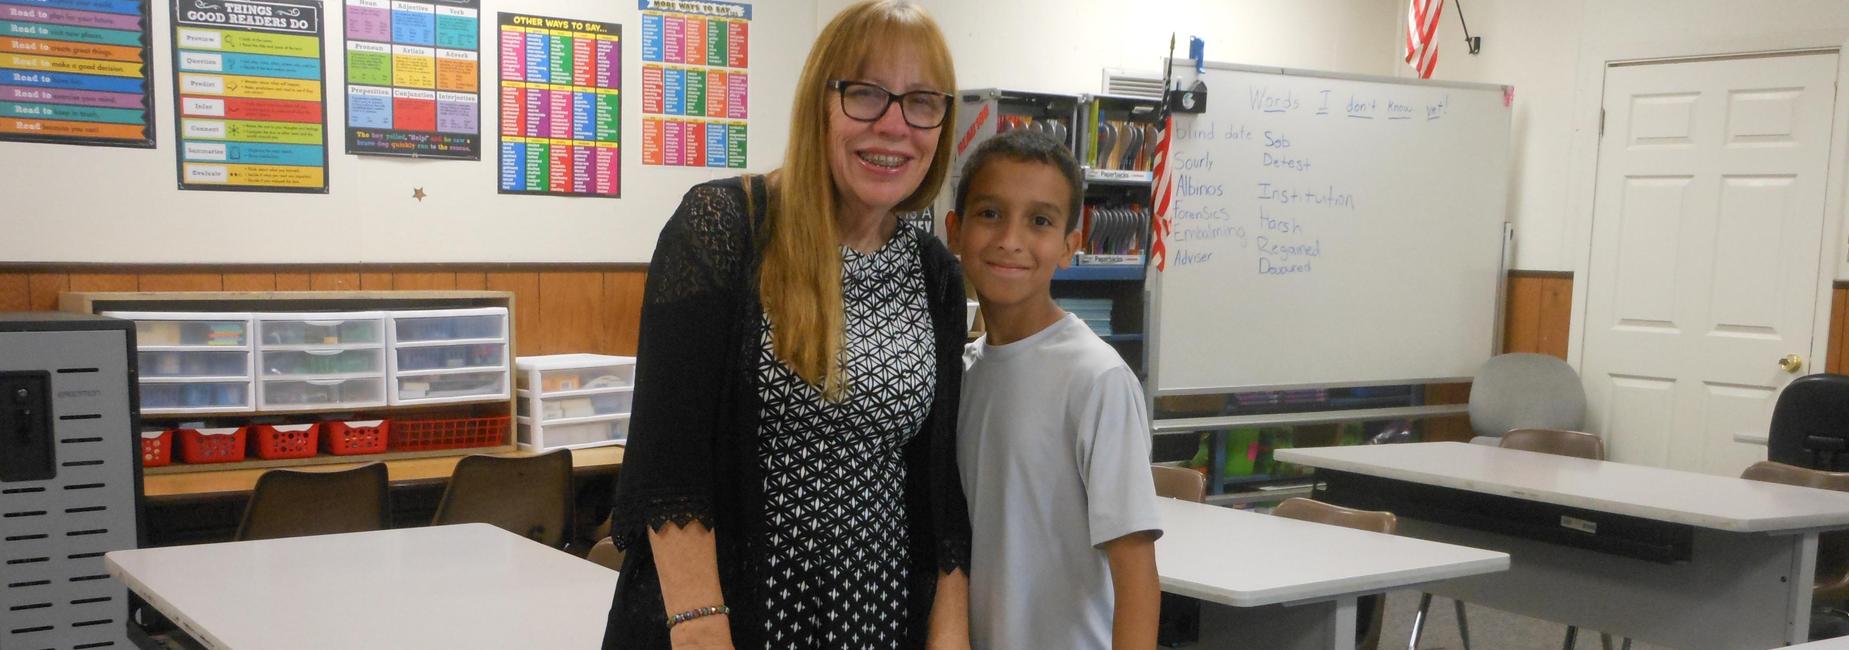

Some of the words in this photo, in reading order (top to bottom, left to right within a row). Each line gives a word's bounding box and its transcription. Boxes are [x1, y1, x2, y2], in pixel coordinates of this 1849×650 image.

[225, 2, 273, 16] THINGS
[398, 3, 429, 12] Adjective
[449, 8, 464, 16] Verb
[679, 3, 700, 11] WAYS
[9, 8, 36, 18] Read
[38, 9, 48, 18] to
[187, 11, 226, 23] GOOD
[229, 13, 287, 28] READERS
[290, 18, 309, 30] DO
[513, 16, 543, 27] OTHER
[546, 18, 569, 29] WAYS
[571, 21, 583, 31] TO
[585, 23, 608, 33] SAY...
[10, 24, 36, 34] Read
[39, 25, 49, 35] to
[12, 40, 37, 50] Read
[40, 41, 49, 51] to
[355, 43, 384, 51] Pronoun
[402, 47, 425, 55] Article
[12, 57, 38, 66] Read
[40, 58, 50, 67] to
[51, 61, 70, 69] make
[79, 63, 96, 72] good
[186, 57, 217, 66] Question
[13, 73, 39, 82] Read
[41, 74, 51, 83] to
[190, 80, 216, 88] Predict
[15, 89, 39, 98] Read
[43, 90, 52, 99] to
[351, 87, 389, 97] Preposition
[394, 89, 434, 99] Conjunction
[438, 93, 476, 102] Interjection
[1249, 86, 1299, 110] Words
[1318, 90, 1331, 110] I
[1346, 95, 1376, 112] don't
[16, 105, 40, 114] Read
[43, 106, 53, 115] to
[16, 121, 41, 130] Read
[1175, 119, 1215, 140] blind
[1225, 123, 1253, 140] date
[356, 131, 370, 139] The
[1174, 151, 1214, 171] Sourly
[1263, 152, 1311, 171] Detest
[1176, 174, 1224, 197] Albinos
[1174, 248, 1213, 266] Adviser
